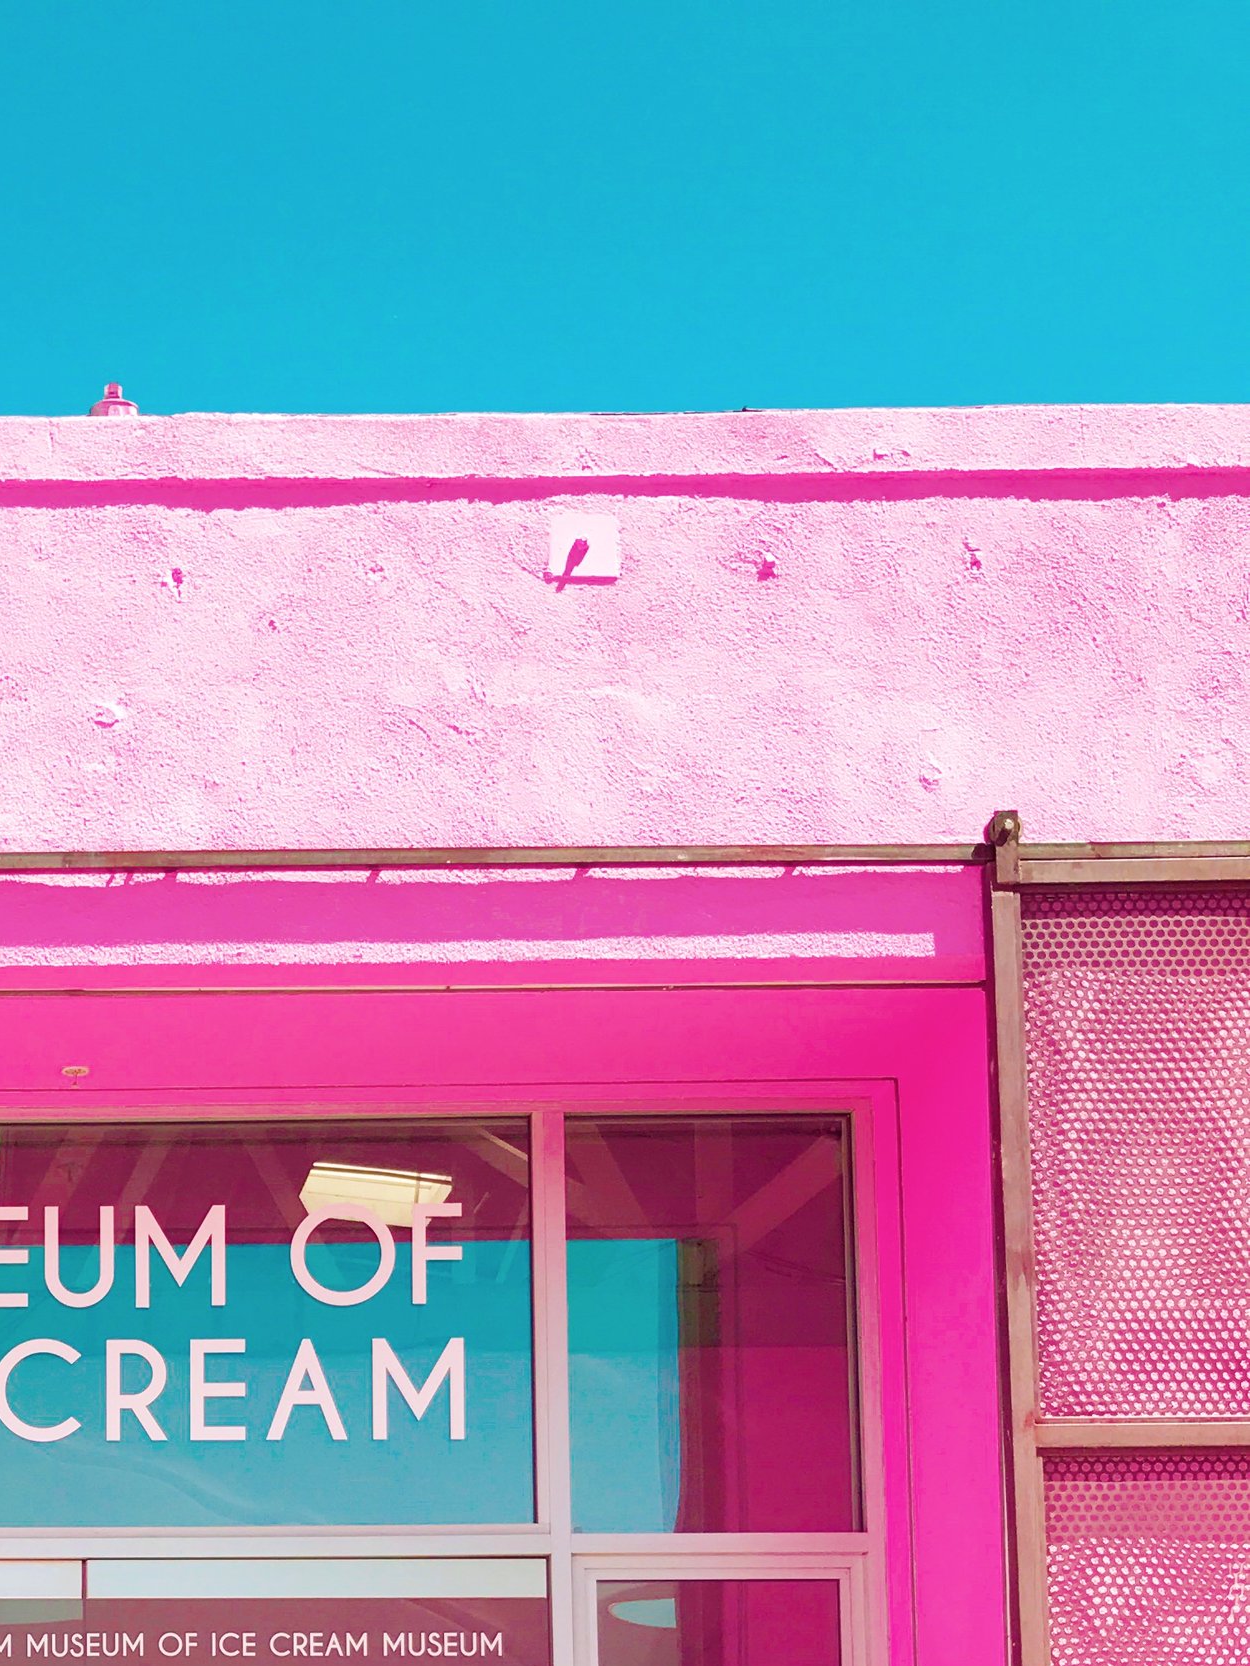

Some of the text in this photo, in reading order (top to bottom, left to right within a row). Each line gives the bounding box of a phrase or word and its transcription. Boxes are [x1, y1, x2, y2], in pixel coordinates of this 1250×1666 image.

[291, 1202, 463, 1305] OF
[26, 1632, 144, 1658] MUSEUM
[158, 1632, 198, 1657] OF
[211, 1632, 256, 1657] ICE
[269, 1632, 368, 1657] CREAM
[383, 1632, 503, 1657] MUSEUM
